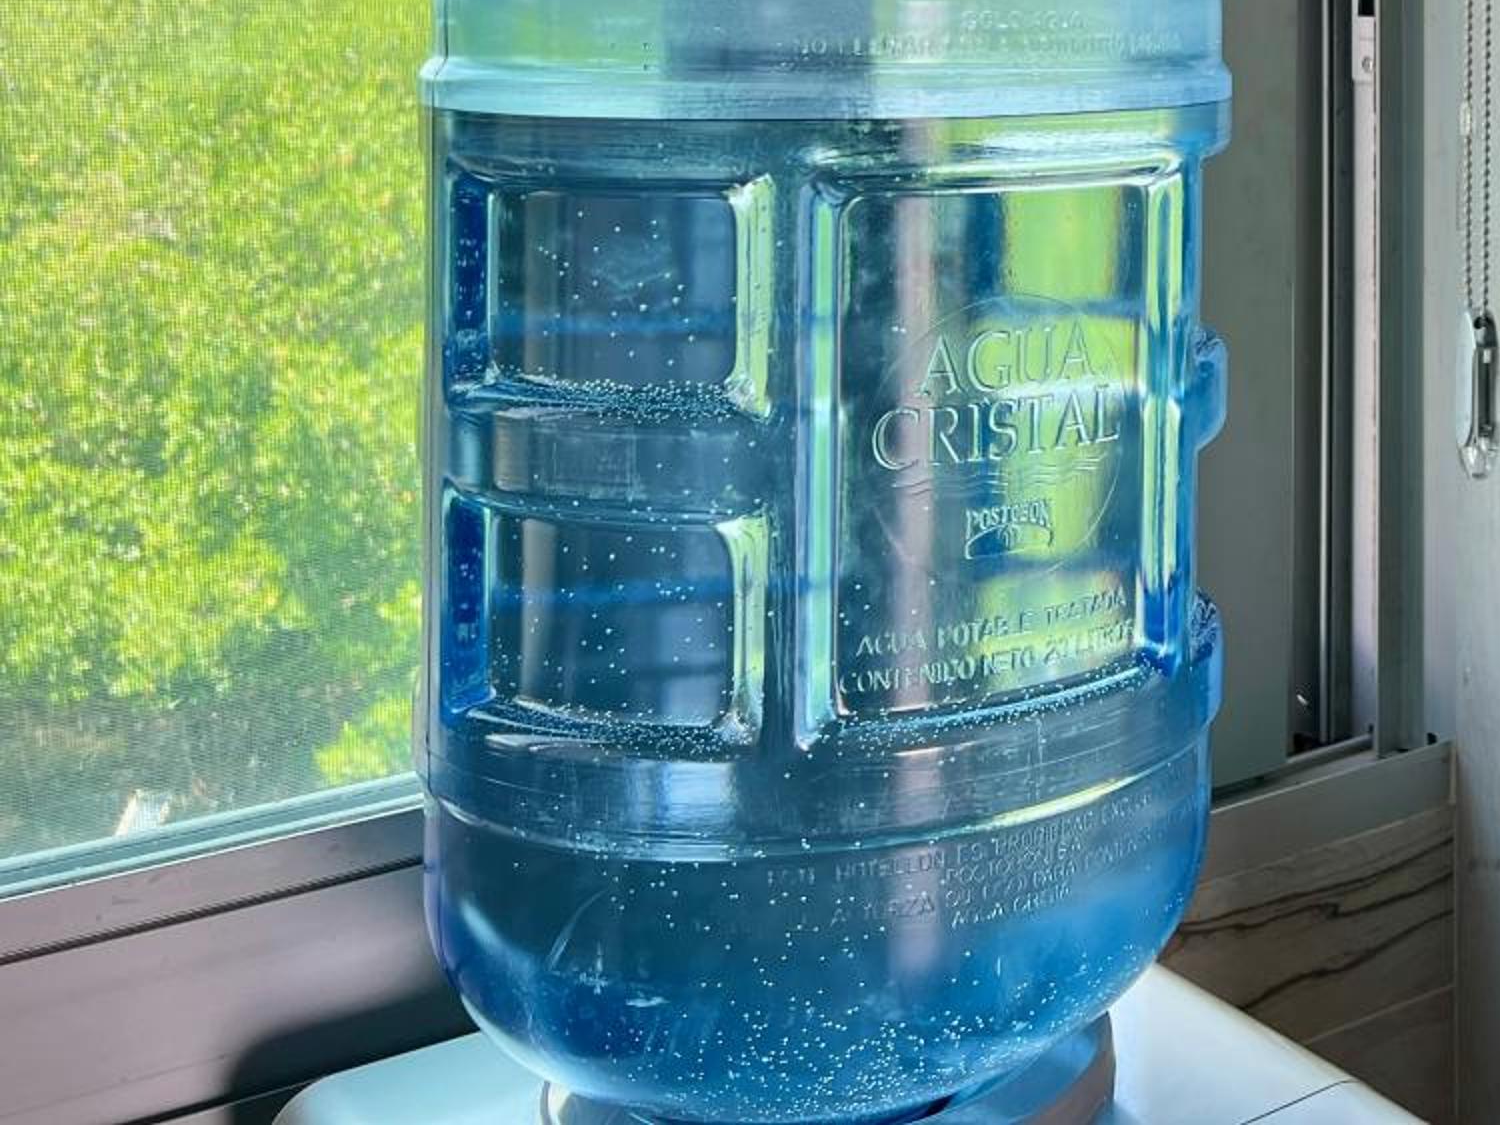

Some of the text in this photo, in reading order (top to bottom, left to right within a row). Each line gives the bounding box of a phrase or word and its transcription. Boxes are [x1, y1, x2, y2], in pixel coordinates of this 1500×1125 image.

[915, 321, 1099, 397] AGUA
[872, 385, 1121, 471] CRISTAL
[855, 629, 928, 657] AGUA
[936, 610, 1035, 650] POTABLE
[839, 653, 975, 694] CONTENIDO
[981, 646, 1036, 677] NETO
